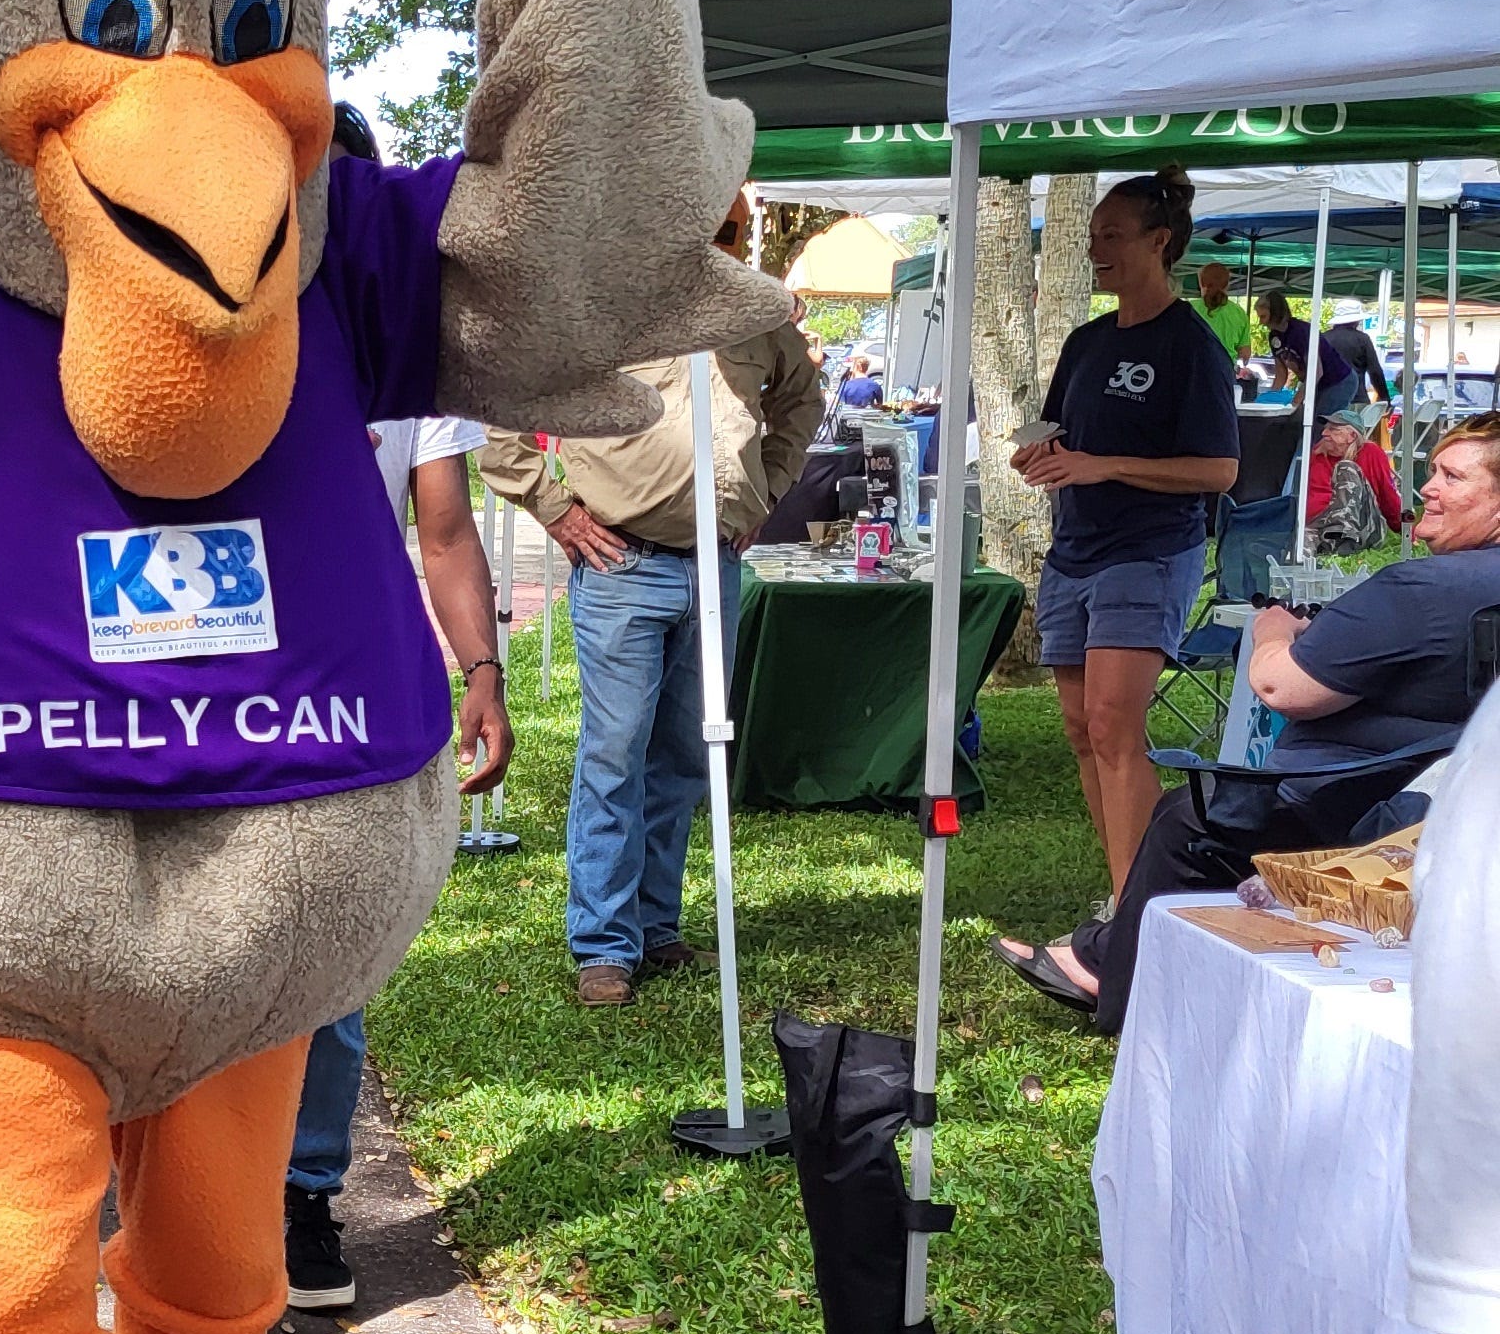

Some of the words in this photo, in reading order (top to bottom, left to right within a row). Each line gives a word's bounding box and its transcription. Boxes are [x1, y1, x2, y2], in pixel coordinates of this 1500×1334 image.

[1108, 361, 1155, 393] 30
[82, 528, 265, 619] KBB
[121, 645, 164, 655] AMERICA
[168, 641, 219, 652] BEAUTIFUL
[222, 637, 269, 647] AFFILIATE
[234, 695, 370, 745] CAN
